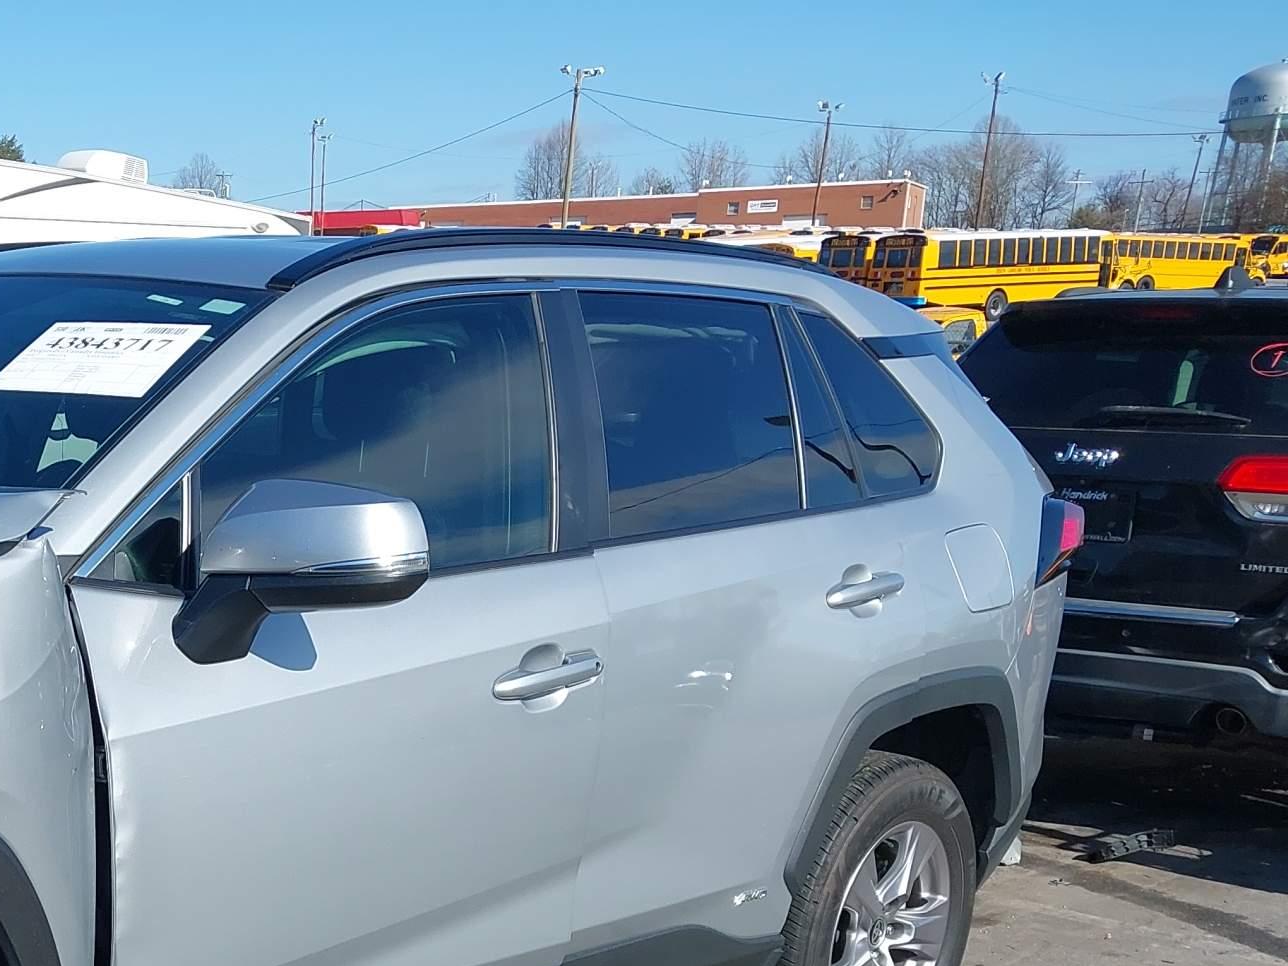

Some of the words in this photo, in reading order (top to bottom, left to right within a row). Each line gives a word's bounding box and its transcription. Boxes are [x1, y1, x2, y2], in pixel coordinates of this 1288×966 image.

[46, 336, 175, 352] 43843717
[1054, 443, 1120, 469] Jeep
[1060, 487, 1109, 501] Hendrick
